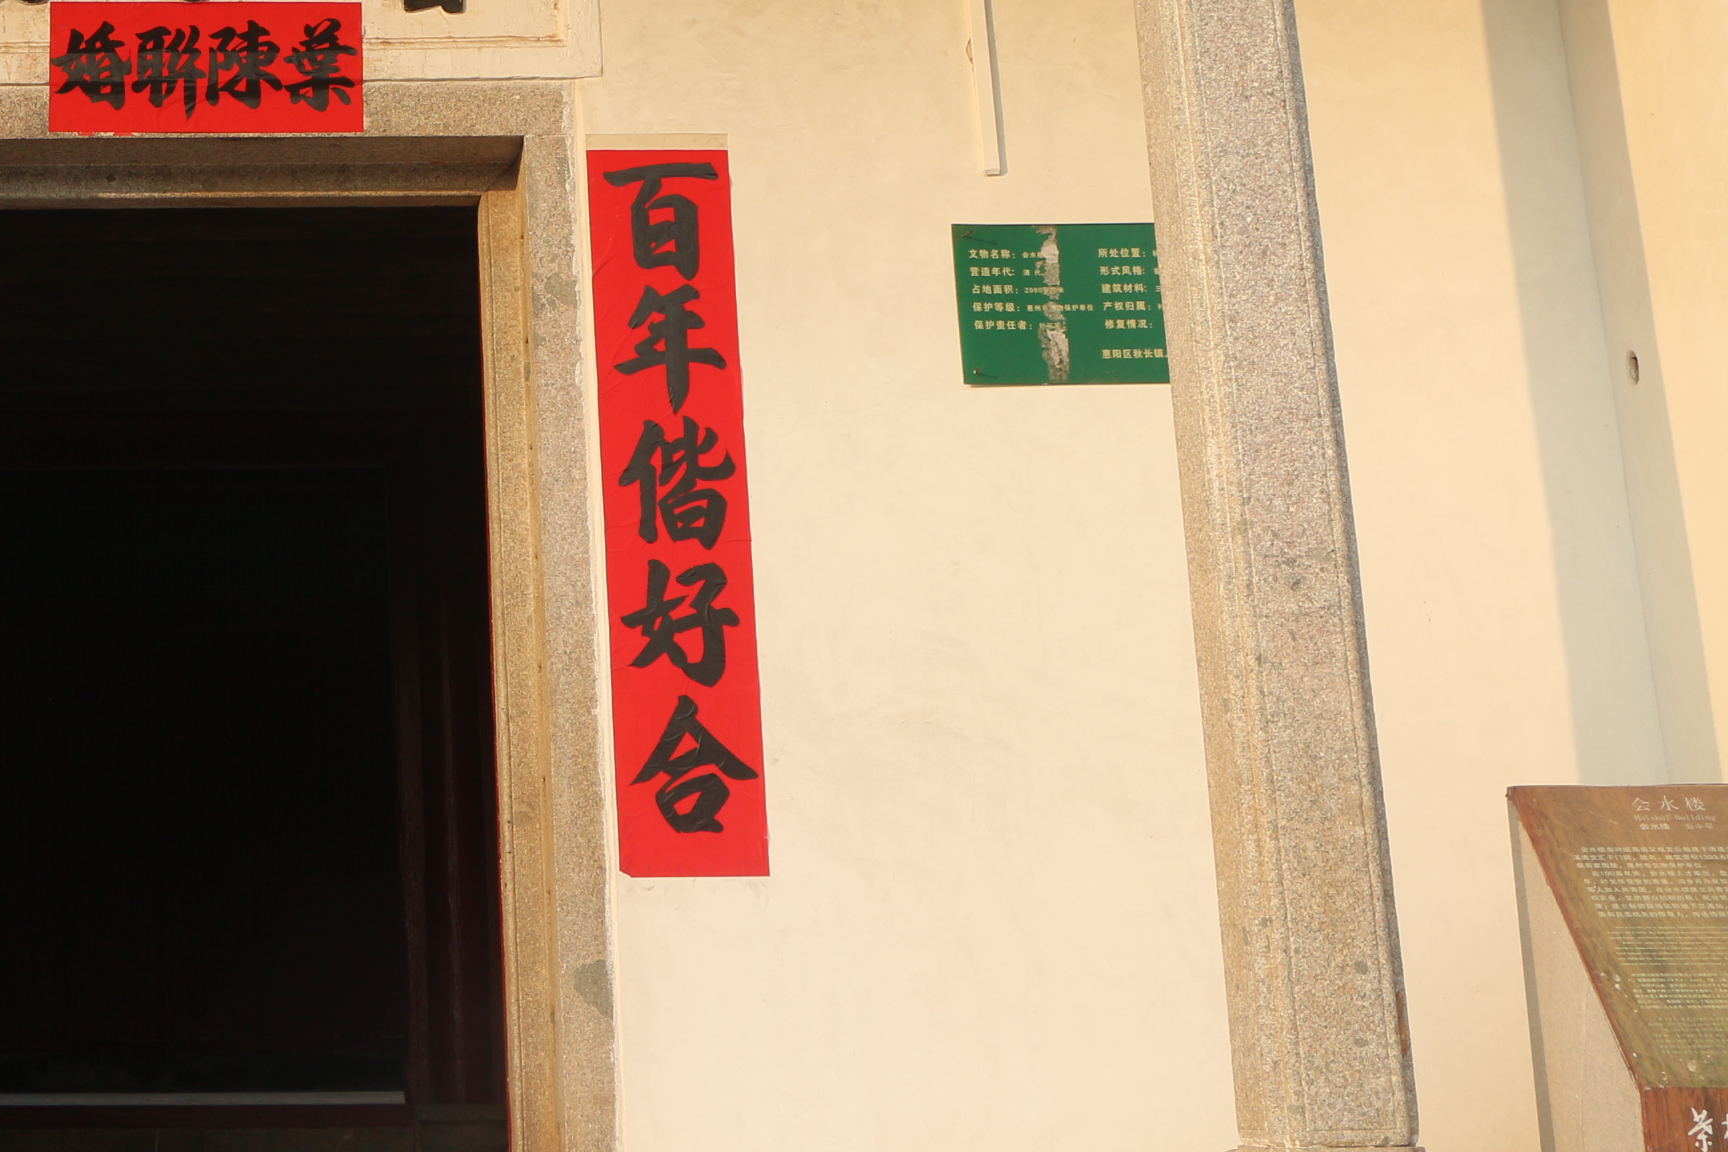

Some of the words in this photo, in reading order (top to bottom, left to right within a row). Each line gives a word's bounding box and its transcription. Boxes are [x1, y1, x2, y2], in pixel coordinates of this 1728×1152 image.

[604, 161, 759, 835] 百年偕好合
